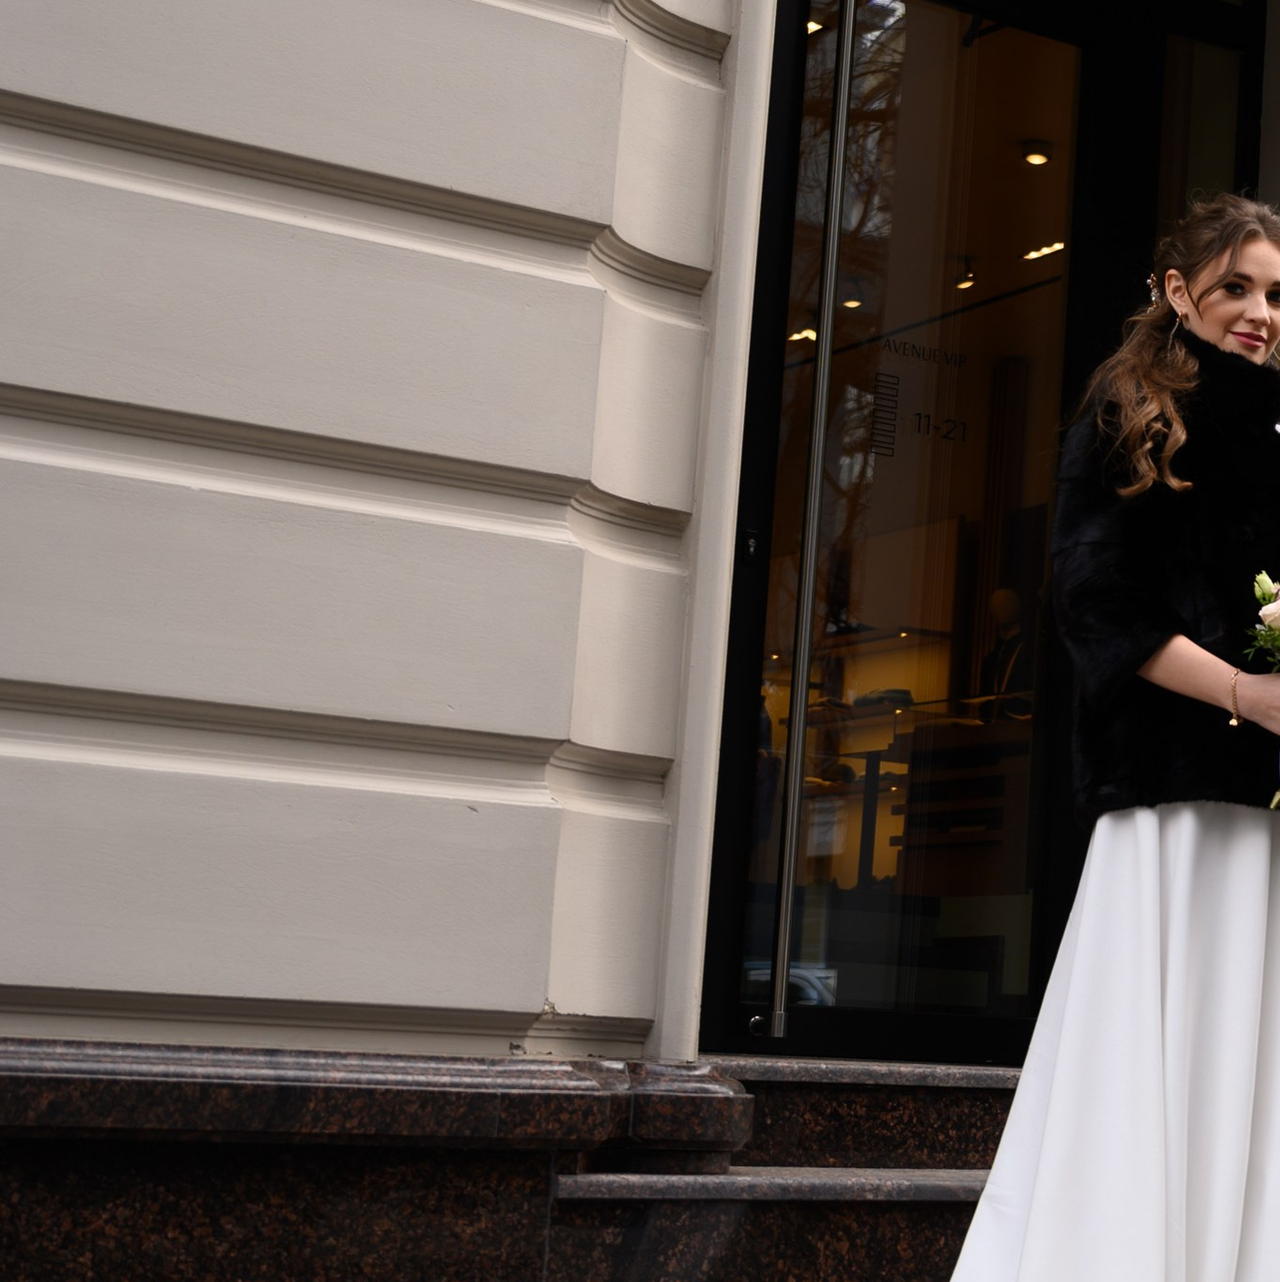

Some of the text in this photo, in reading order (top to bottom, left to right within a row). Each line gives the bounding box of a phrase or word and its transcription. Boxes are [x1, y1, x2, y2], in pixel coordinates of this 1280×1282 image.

[882, 338, 968, 368] AVENUE VIP
[915, 412, 968, 443] 11-21
